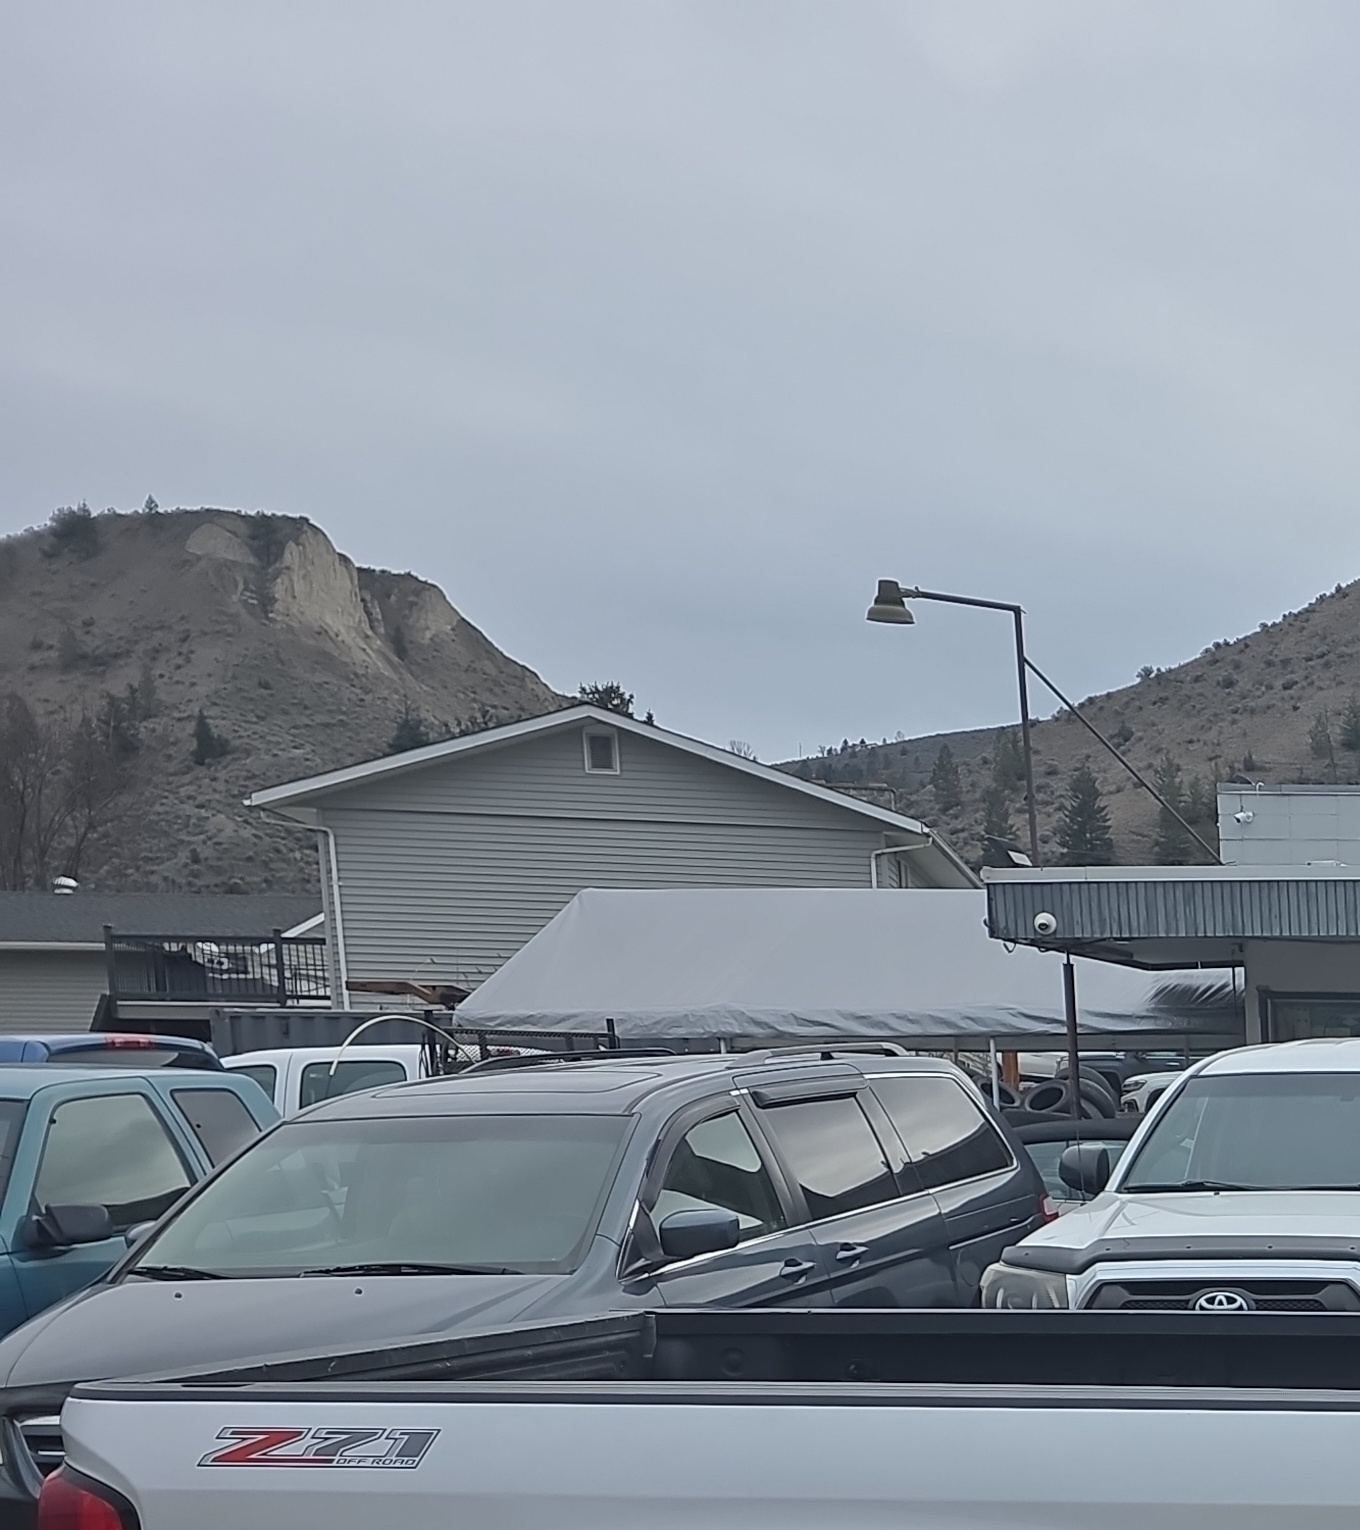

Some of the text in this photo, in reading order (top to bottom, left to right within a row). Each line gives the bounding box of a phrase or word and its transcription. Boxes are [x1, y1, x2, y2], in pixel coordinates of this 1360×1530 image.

[197, 1427, 441, 1469] Z71
[335, 1457, 416, 1466] OFF ROAD
